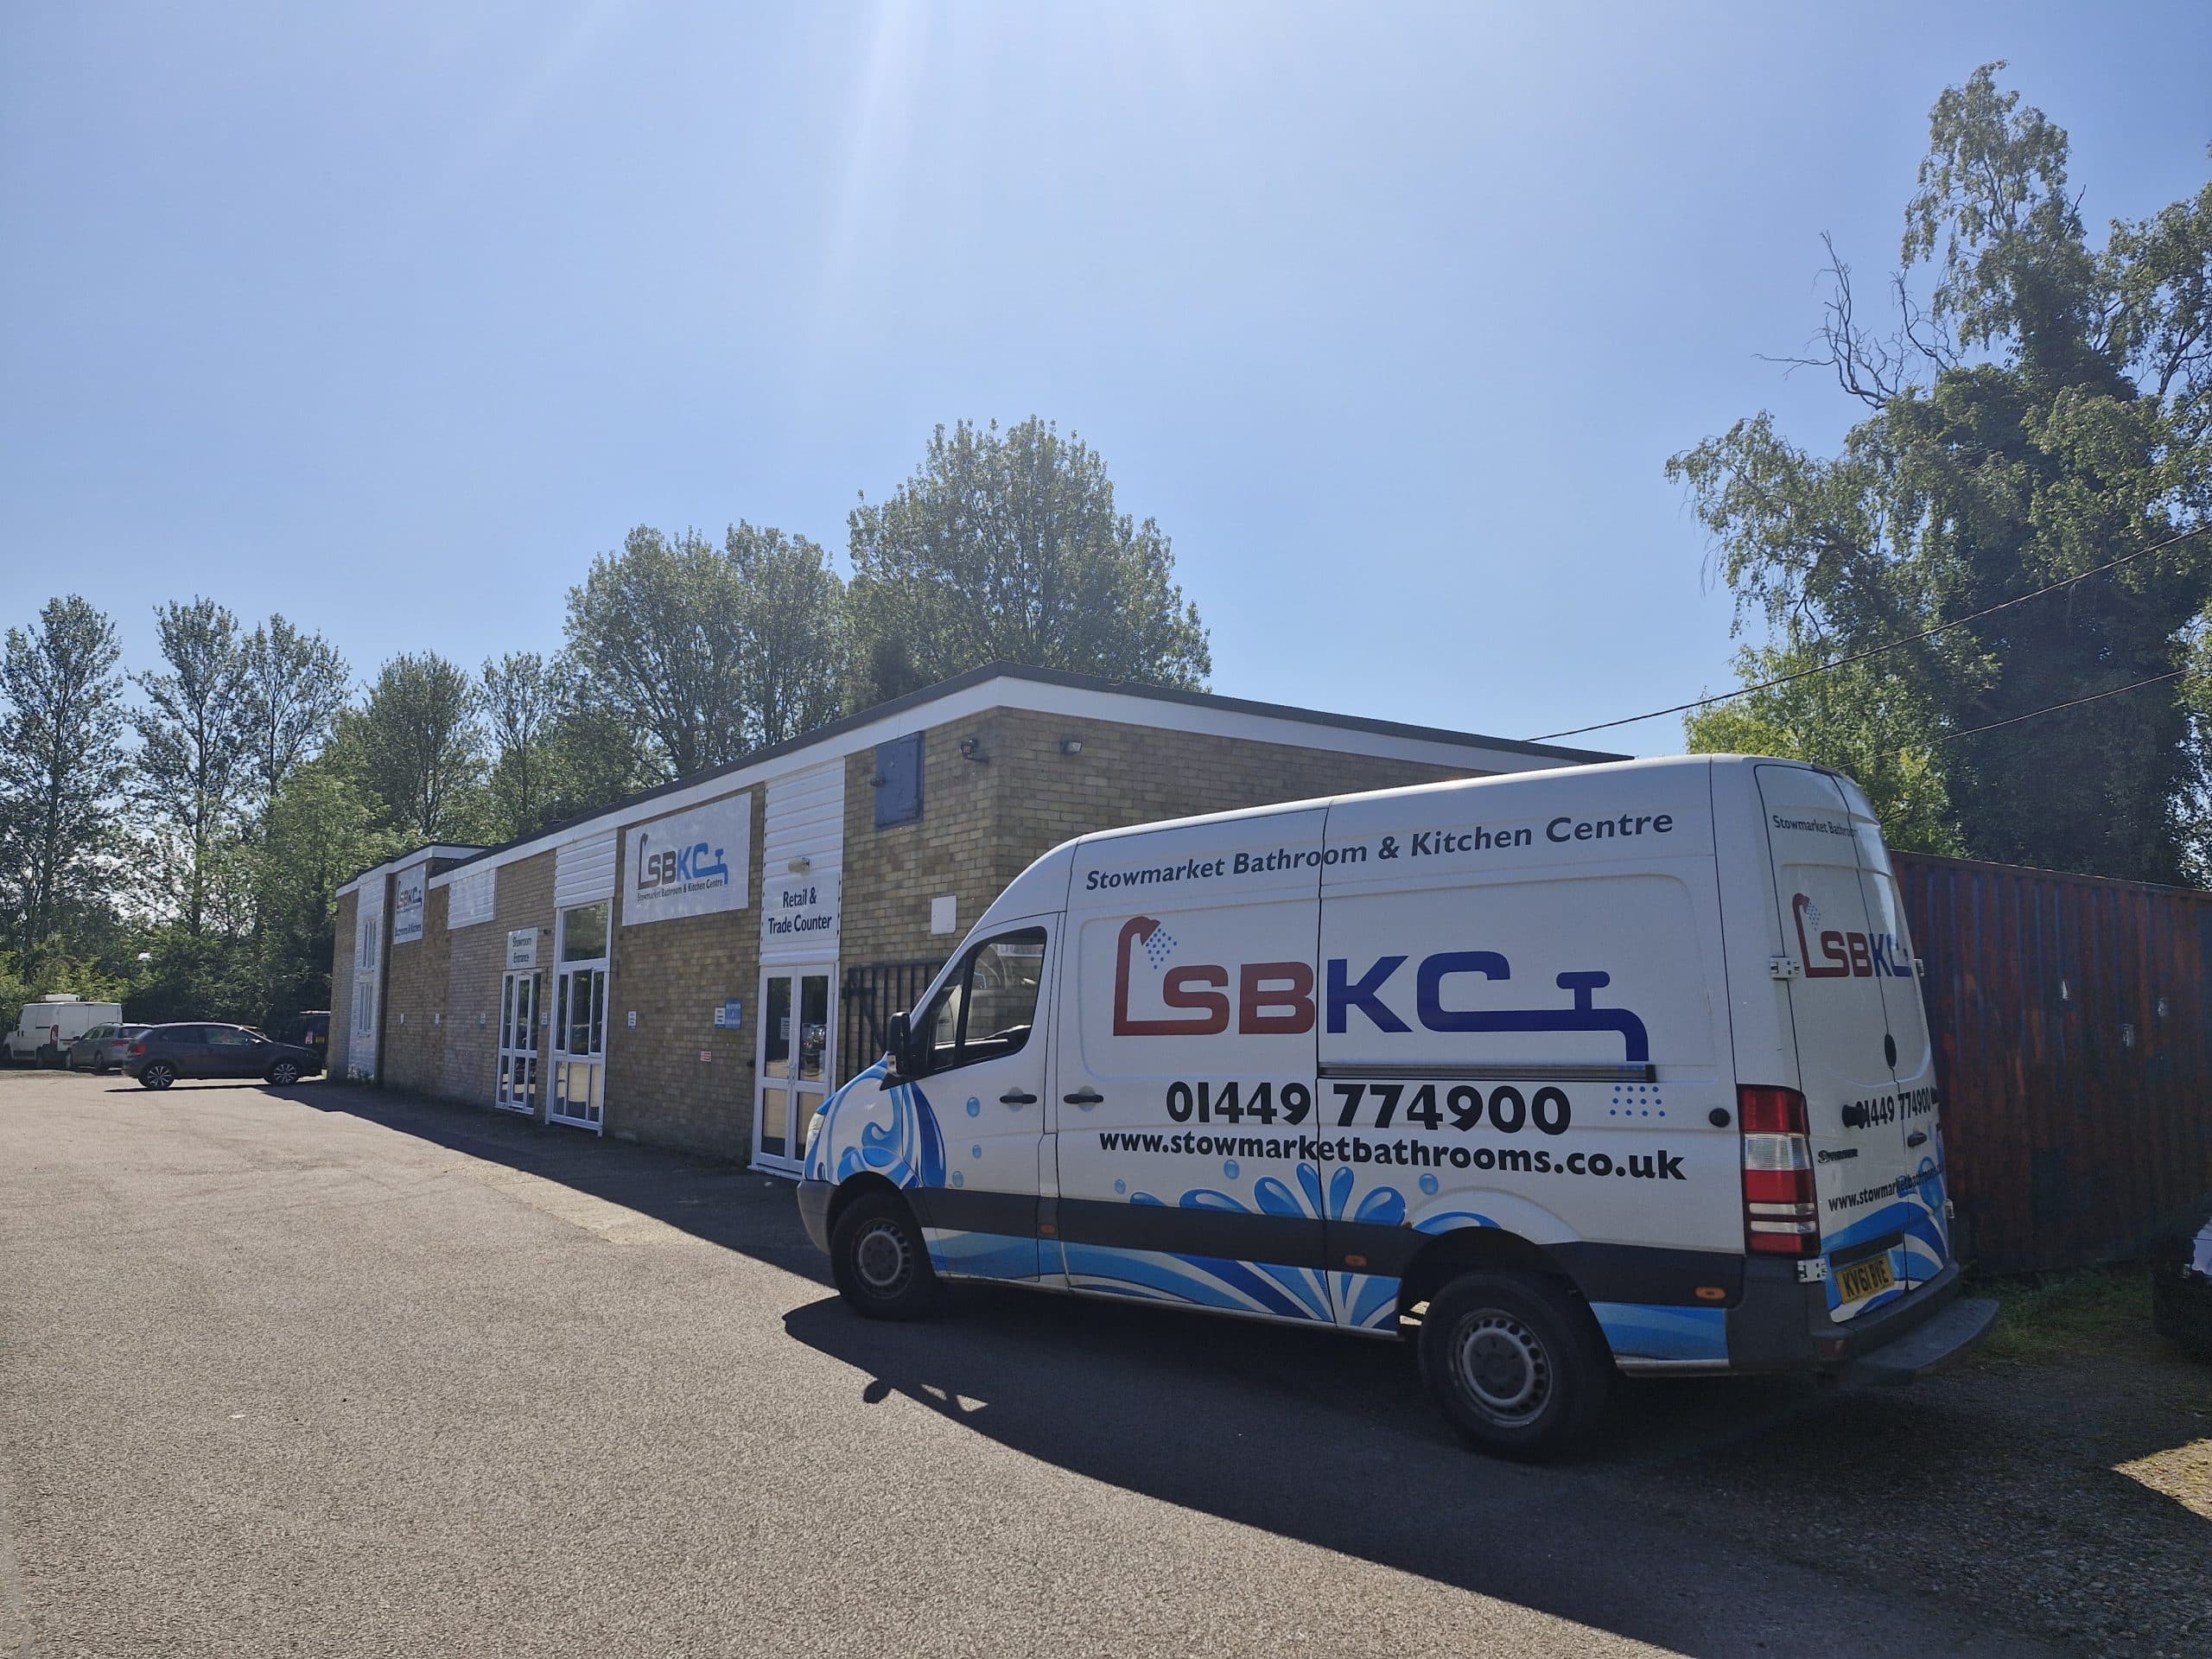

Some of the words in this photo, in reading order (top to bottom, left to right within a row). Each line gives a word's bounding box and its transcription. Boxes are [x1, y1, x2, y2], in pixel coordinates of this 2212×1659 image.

[1772, 815, 1827, 833] Stowmarket
[640, 840, 727, 889] SBKC
[1086, 858, 1224, 891] Stowmarket
[1233, 846, 1367, 874] Bathroom
[1378, 836, 1400, 860] &
[1411, 826, 1532, 857] Kitchen
[1546, 813, 1673, 843] Centre
[662, 885, 683, 897] Bathroom
[688, 880, 705, 892] Kitchen
[706, 879, 723, 888] Centre
[782, 889, 808, 908] Retail
[809, 887, 817, 905] &
[767, 917, 792, 934] Trade
[794, 914, 832, 931] Counter
[1114, 950, 1649, 1037] SBKC
[1166, 1080, 1312, 1125] 01449
[1332, 1084, 1572, 1135] 774900
[1897, 1086, 1931, 1121] 774900
[1099, 1130, 1687, 1180] www.stowmarketbathrooms.co.uk
[1842, 1265, 1872, 1298] KV61
